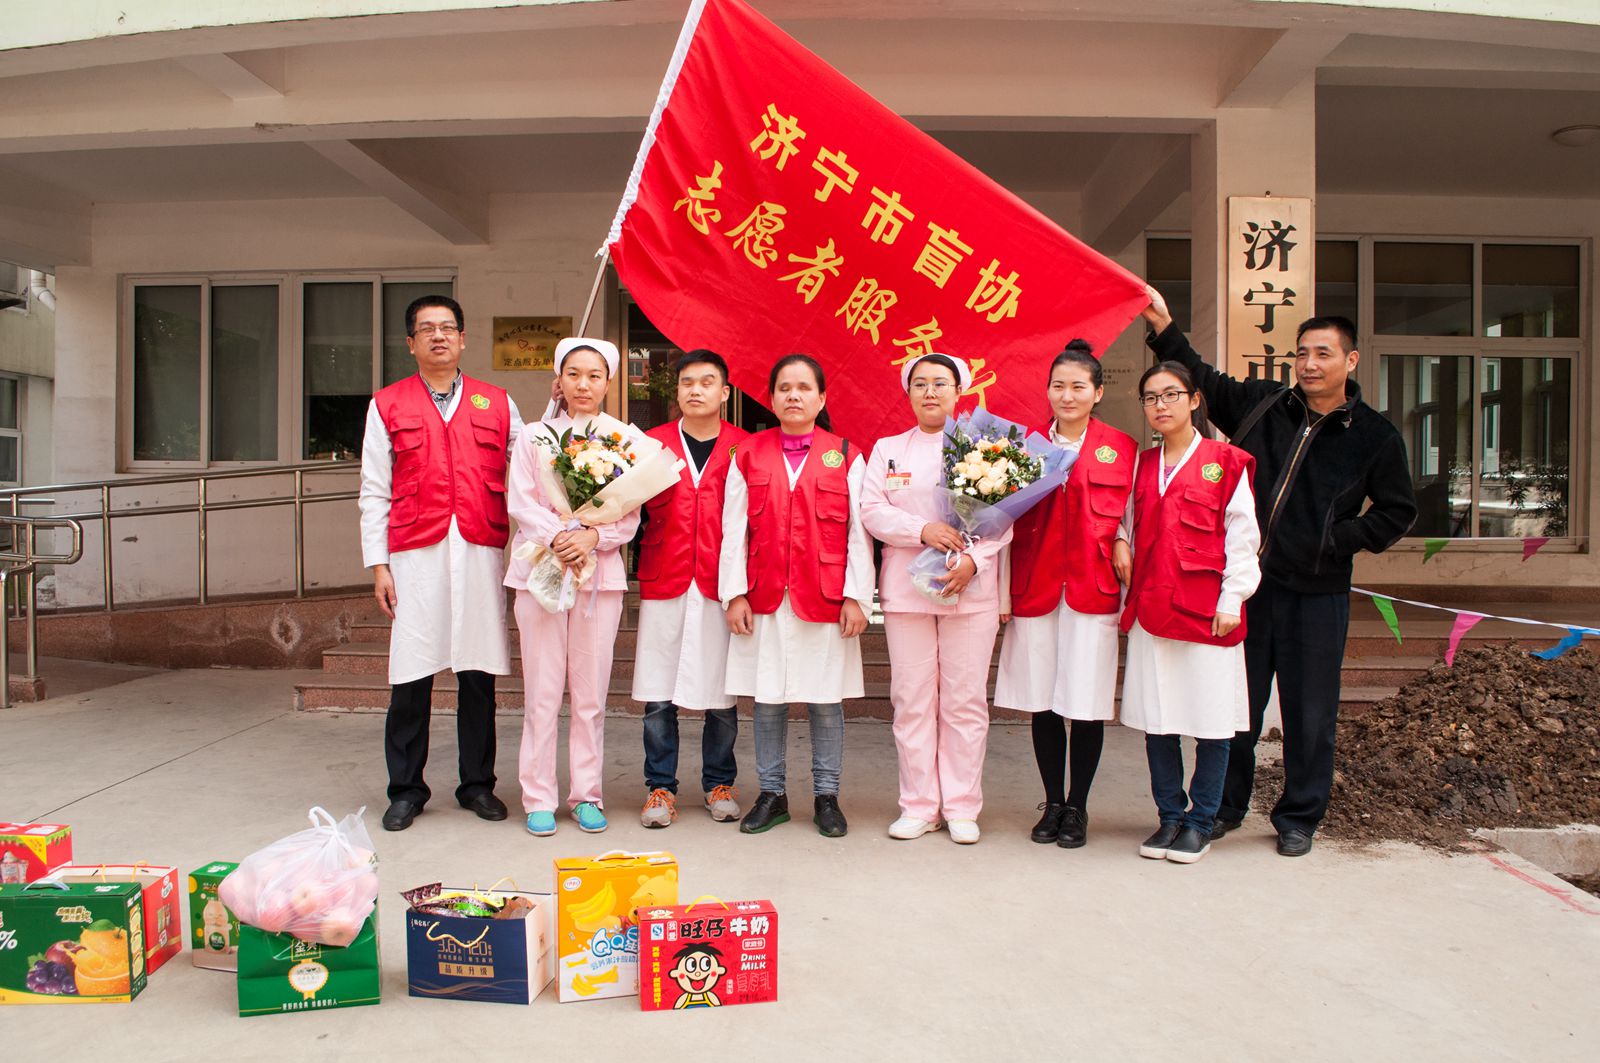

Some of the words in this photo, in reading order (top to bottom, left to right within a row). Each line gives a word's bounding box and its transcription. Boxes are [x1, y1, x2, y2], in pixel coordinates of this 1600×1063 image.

[750, 102, 1023, 324] 济宁市盲协
[1242, 219, 1298, 384] 济宁市
[504, 357, 556, 368] 定点服务单
[680, 915, 770, 939] 旺仔牛奶
[741, 953, 767, 961] DRINK
[741, 961, 767, 970] MILK
